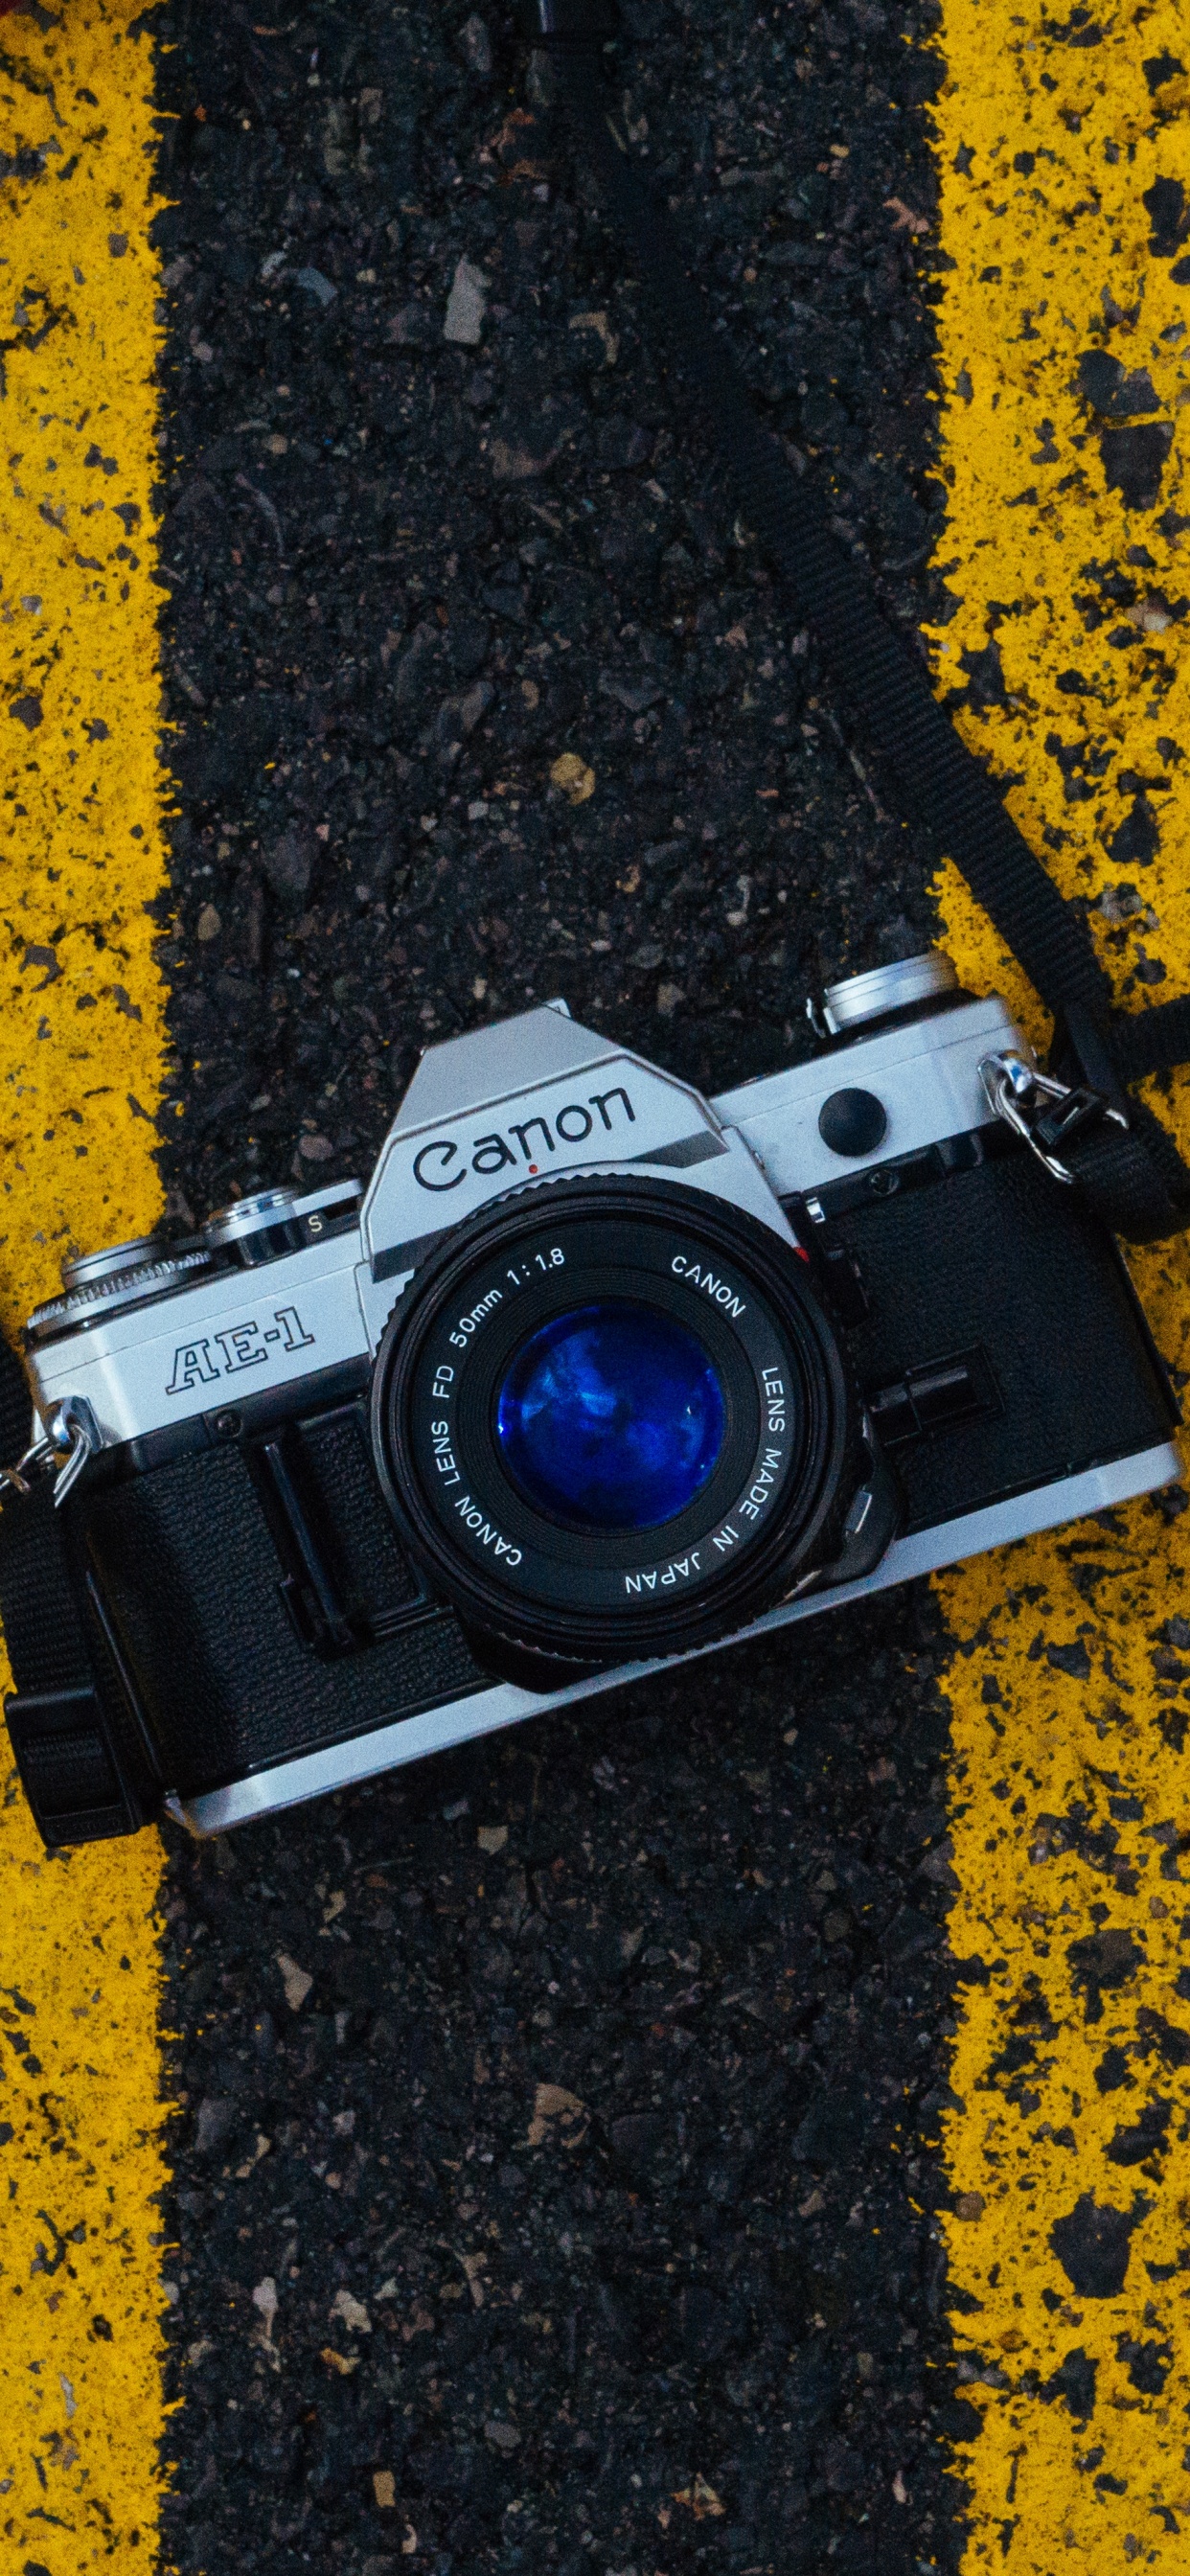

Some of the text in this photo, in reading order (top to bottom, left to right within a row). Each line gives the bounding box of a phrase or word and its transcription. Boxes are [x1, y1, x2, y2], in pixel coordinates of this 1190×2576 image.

[412, 1087, 636, 1192] Canon
[308, 1214, 323, 1233] S
[165, 1306, 316, 1396] AE-1
[448, 1289, 503, 1348] 50mm
[432, 1365, 454, 1399] FD
[430, 1420, 461, 1485] LENS
[625, 1255, 786, 1594] CANON LENS MADE IN JAPAN
[454, 1495, 522, 1566] CANON
